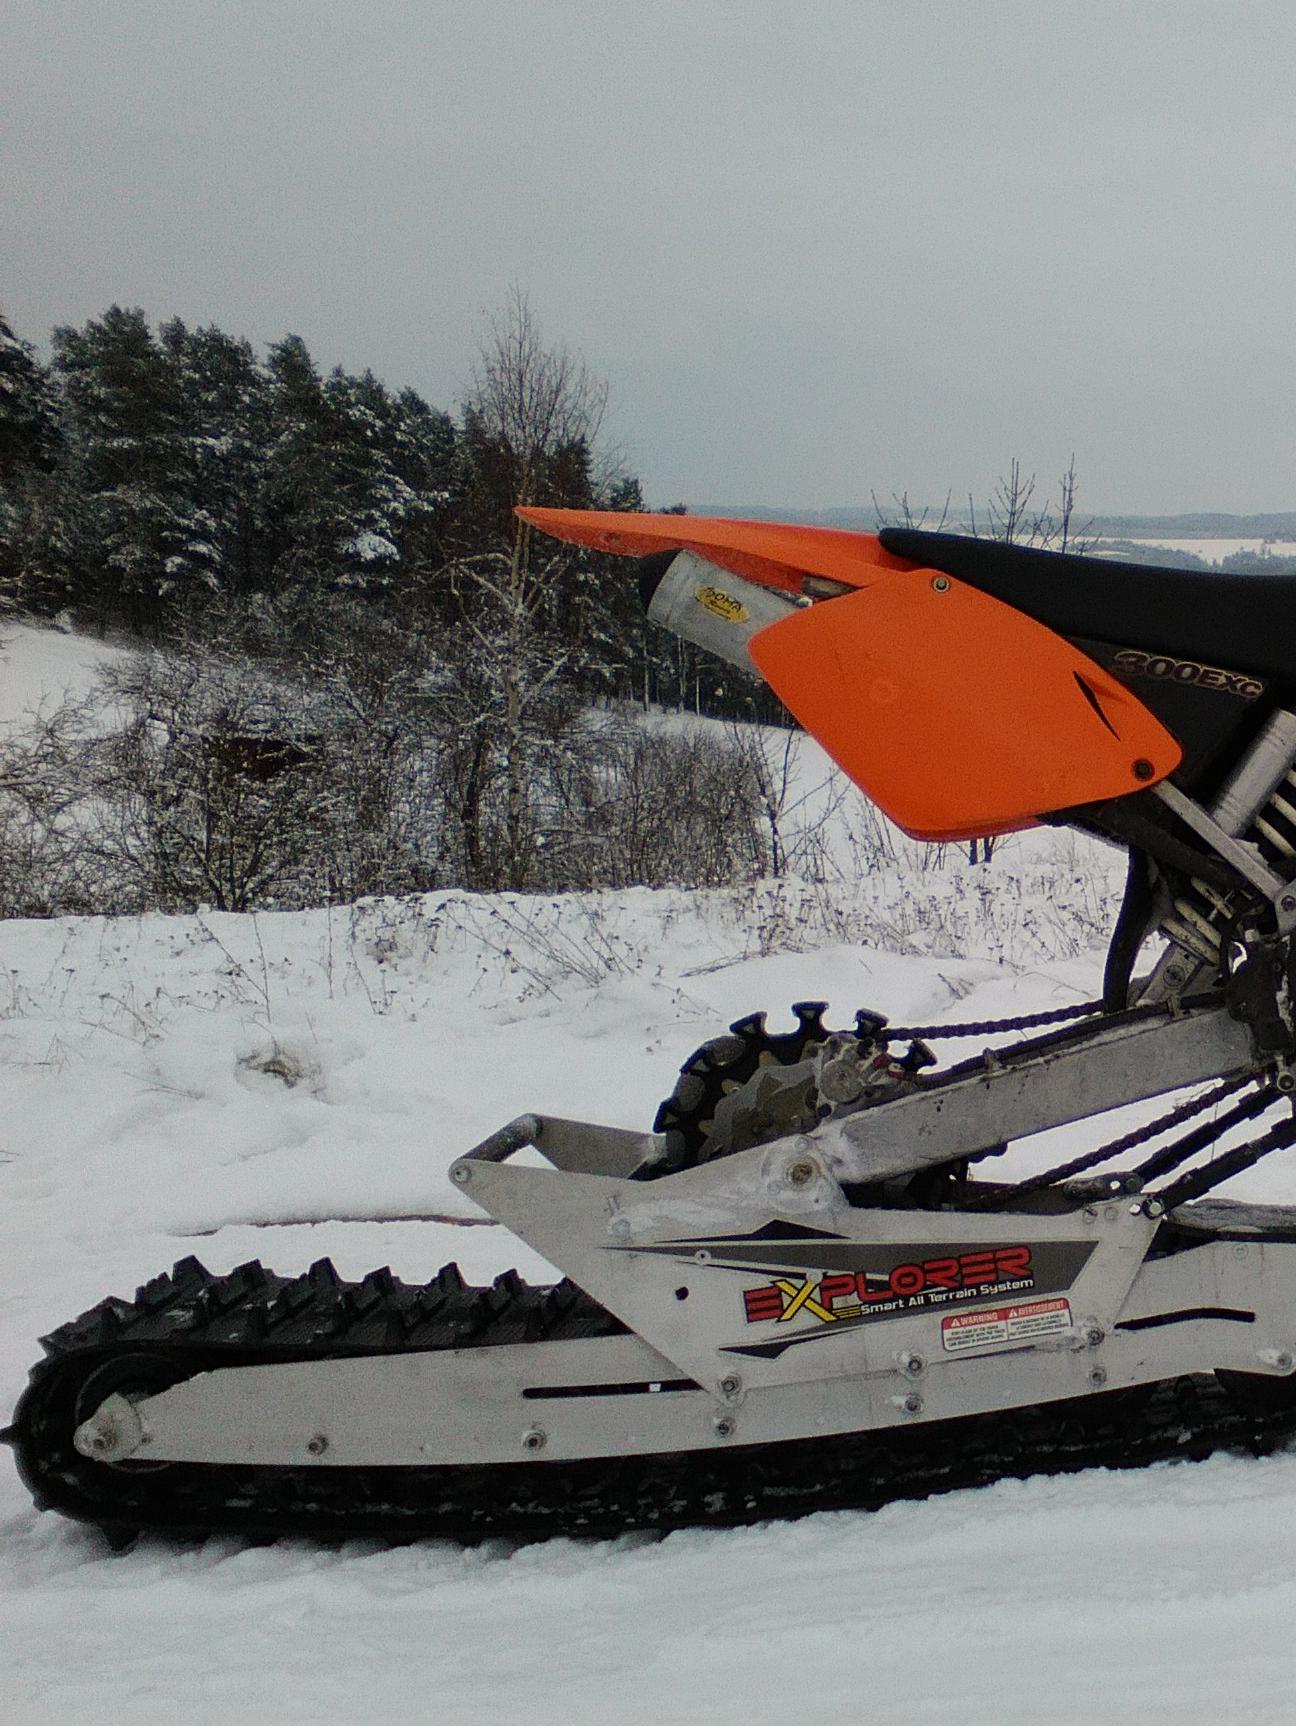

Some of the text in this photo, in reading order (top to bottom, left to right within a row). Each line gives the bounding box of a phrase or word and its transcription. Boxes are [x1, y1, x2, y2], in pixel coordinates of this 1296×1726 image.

[743, 1245, 1032, 1323] EXPLORER
[860, 1278, 1034, 1315] Smart All Terrain System
[960, 1312, 998, 1325] WARNING
